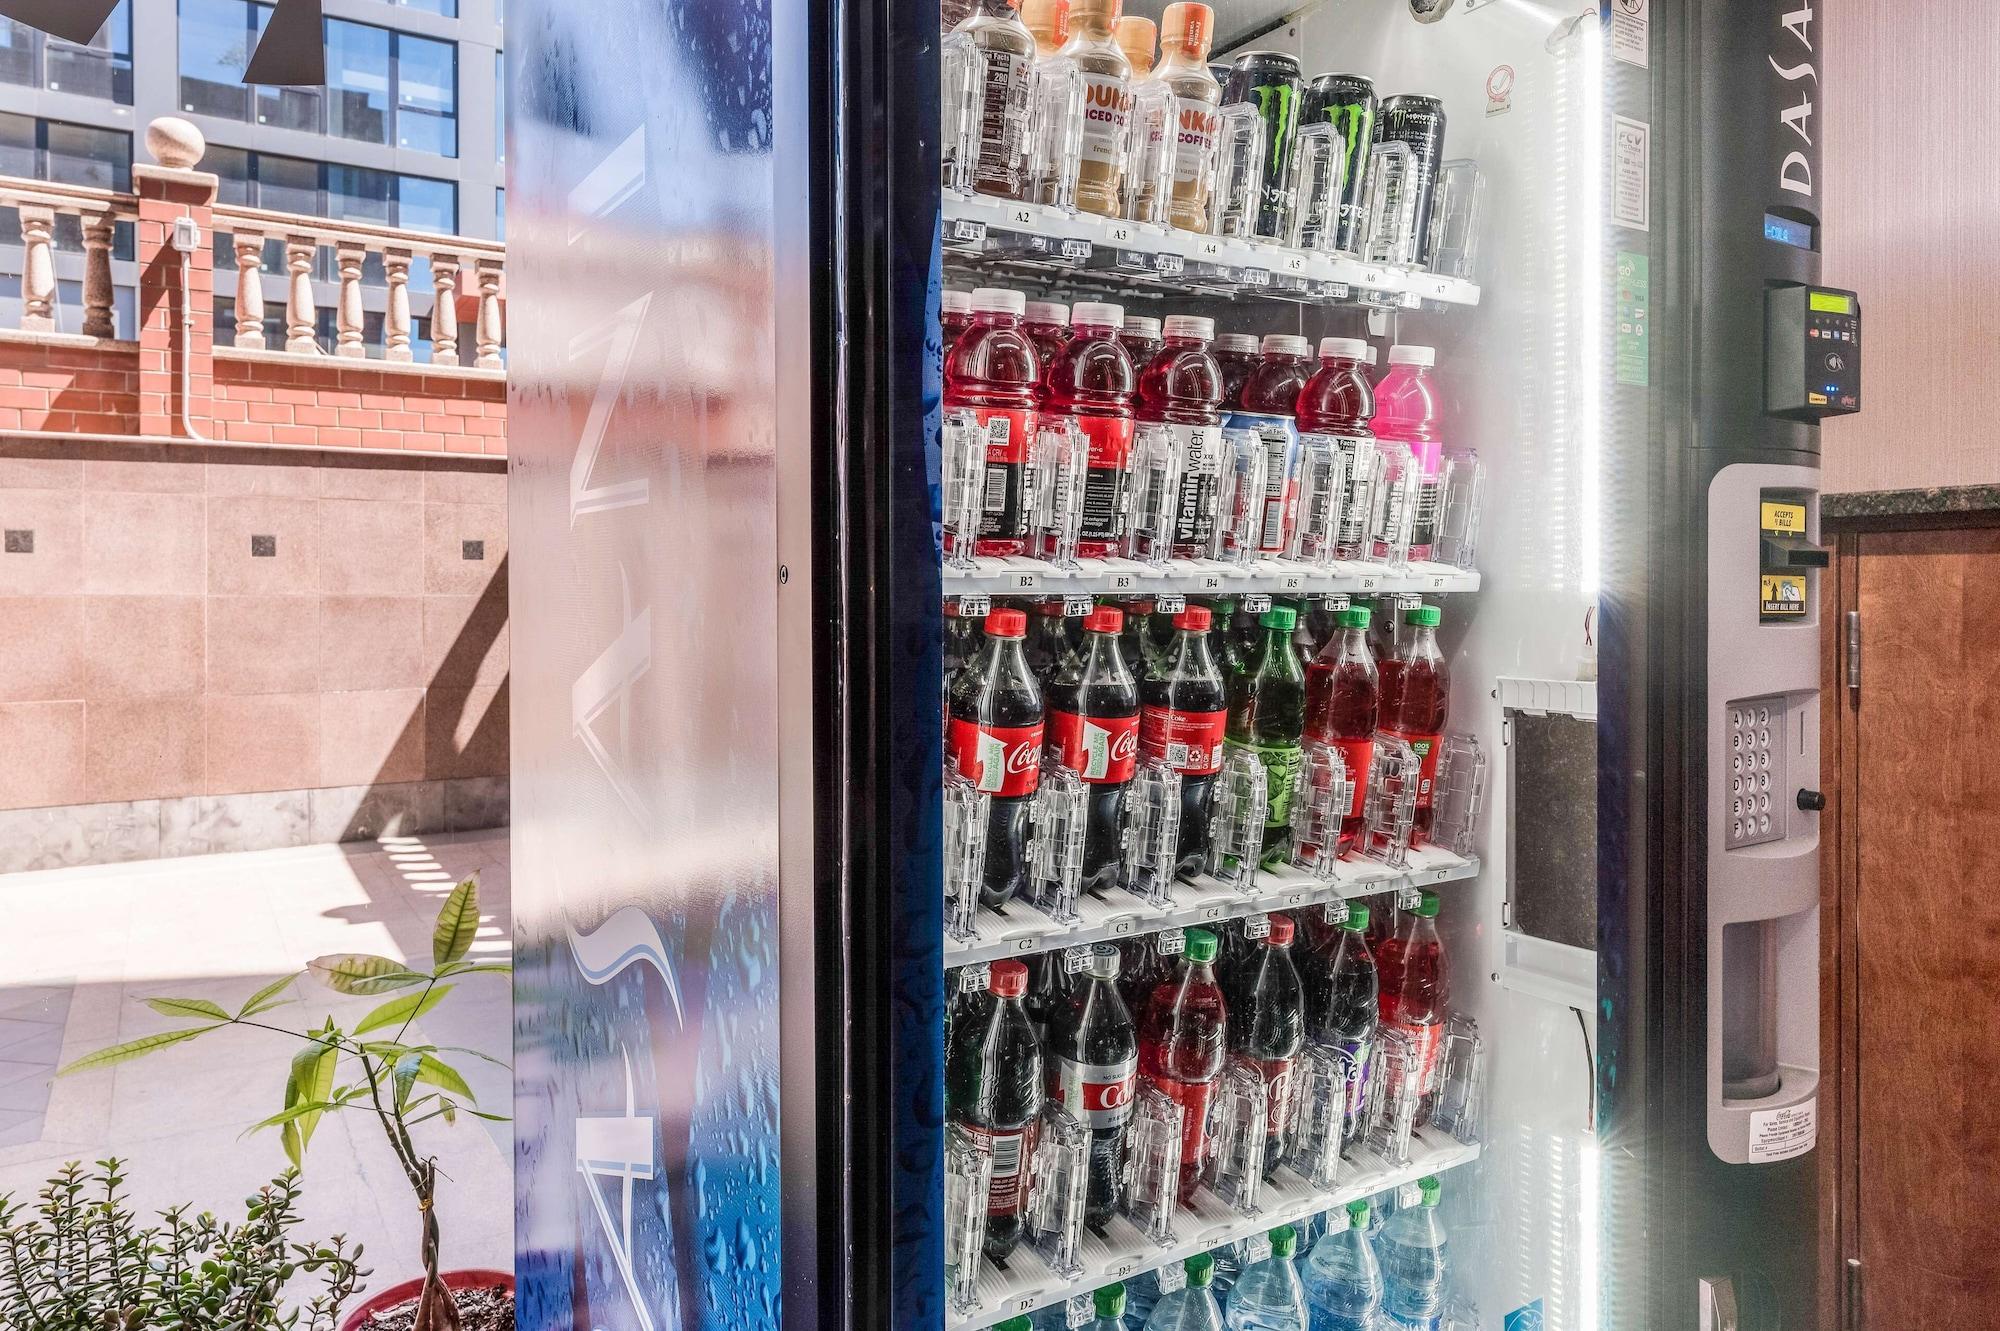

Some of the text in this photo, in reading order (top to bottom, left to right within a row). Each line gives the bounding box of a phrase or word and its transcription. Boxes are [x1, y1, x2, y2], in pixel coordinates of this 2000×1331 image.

[1768, 0, 1818, 197] DASA
[1086, 109, 1112, 123] ICED
[1015, 212, 1030, 223] A2
[1114, 230, 1127, 240] A3
[1203, 243, 1217, 254] A4
[1289, 258, 1301, 270] A5
[1366, 273, 1376, 283] A6
[1435, 285, 1446, 294] A7
[1019, 576, 1034, 588] B2
[1116, 577, 1130, 588] B3
[1206, 578, 1218, 589] B4
[1287, 578, 1298, 589] B5
[1364, 578, 1375, 588] B6
[1434, 578, 1445, 588] B7
[1733, 713, 1739, 725] A
[1748, 712, 1752, 723] 1
[1760, 711, 1766, 722] 2
[1733, 735, 1739, 747] B
[1747, 734, 1752, 745] 3
[1760, 732, 1766, 743] 4
[1733, 757, 1739, 769] C
[1747, 755, 1752, 767] 5
[1760, 753, 1766, 765] 6
[1733, 779, 1739, 791] D
[1747, 777, 1752, 789] 7
[1760, 775, 1766, 787] 8
[1733, 801, 1739, 813] E
[1747, 799, 1752, 810] 9
[1760, 797, 1766, 808] 0
[1733, 823, 1739, 835] F
[1436, 870, 1447, 880] C7
[1365, 881, 1376, 891] C6
[1289, 894, 1300, 905] C5
[1206, 907, 1219, 918] C4
[1115, 922, 1129, 933] C3
[1018, 939, 1033, 950] C2
[1118, 1265, 1131, 1276] D3
[1019, 1298, 1034, 1311] D2
